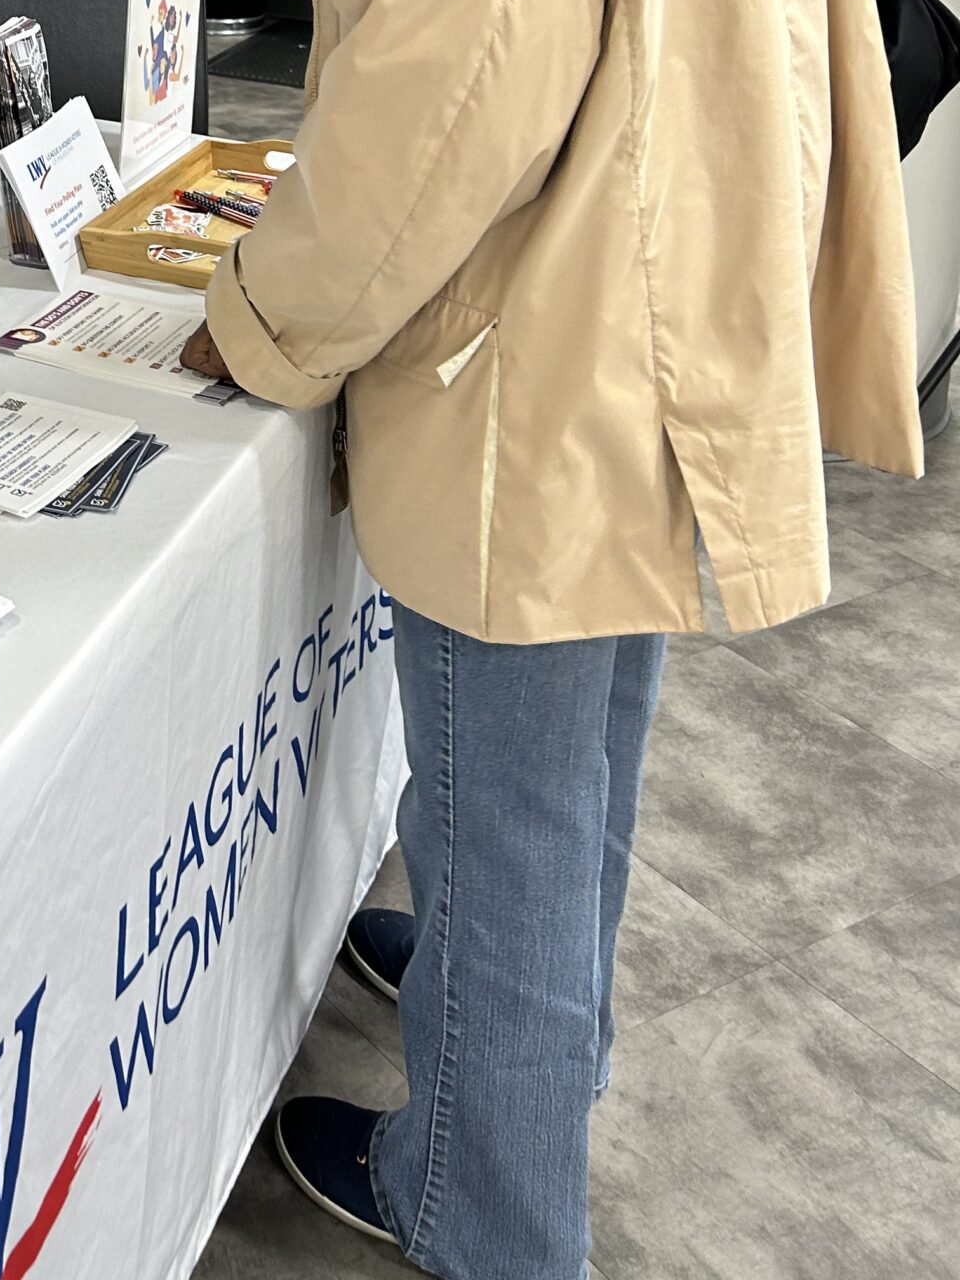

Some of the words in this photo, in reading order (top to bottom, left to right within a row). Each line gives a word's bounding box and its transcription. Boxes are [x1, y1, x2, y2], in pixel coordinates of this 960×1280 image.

[26, 155, 47, 182] LWV
[110, 759, 279, 1111] WOMEN
[115, 659, 280, 1000] LEAGUE
[292, 604, 334, 703] OF
